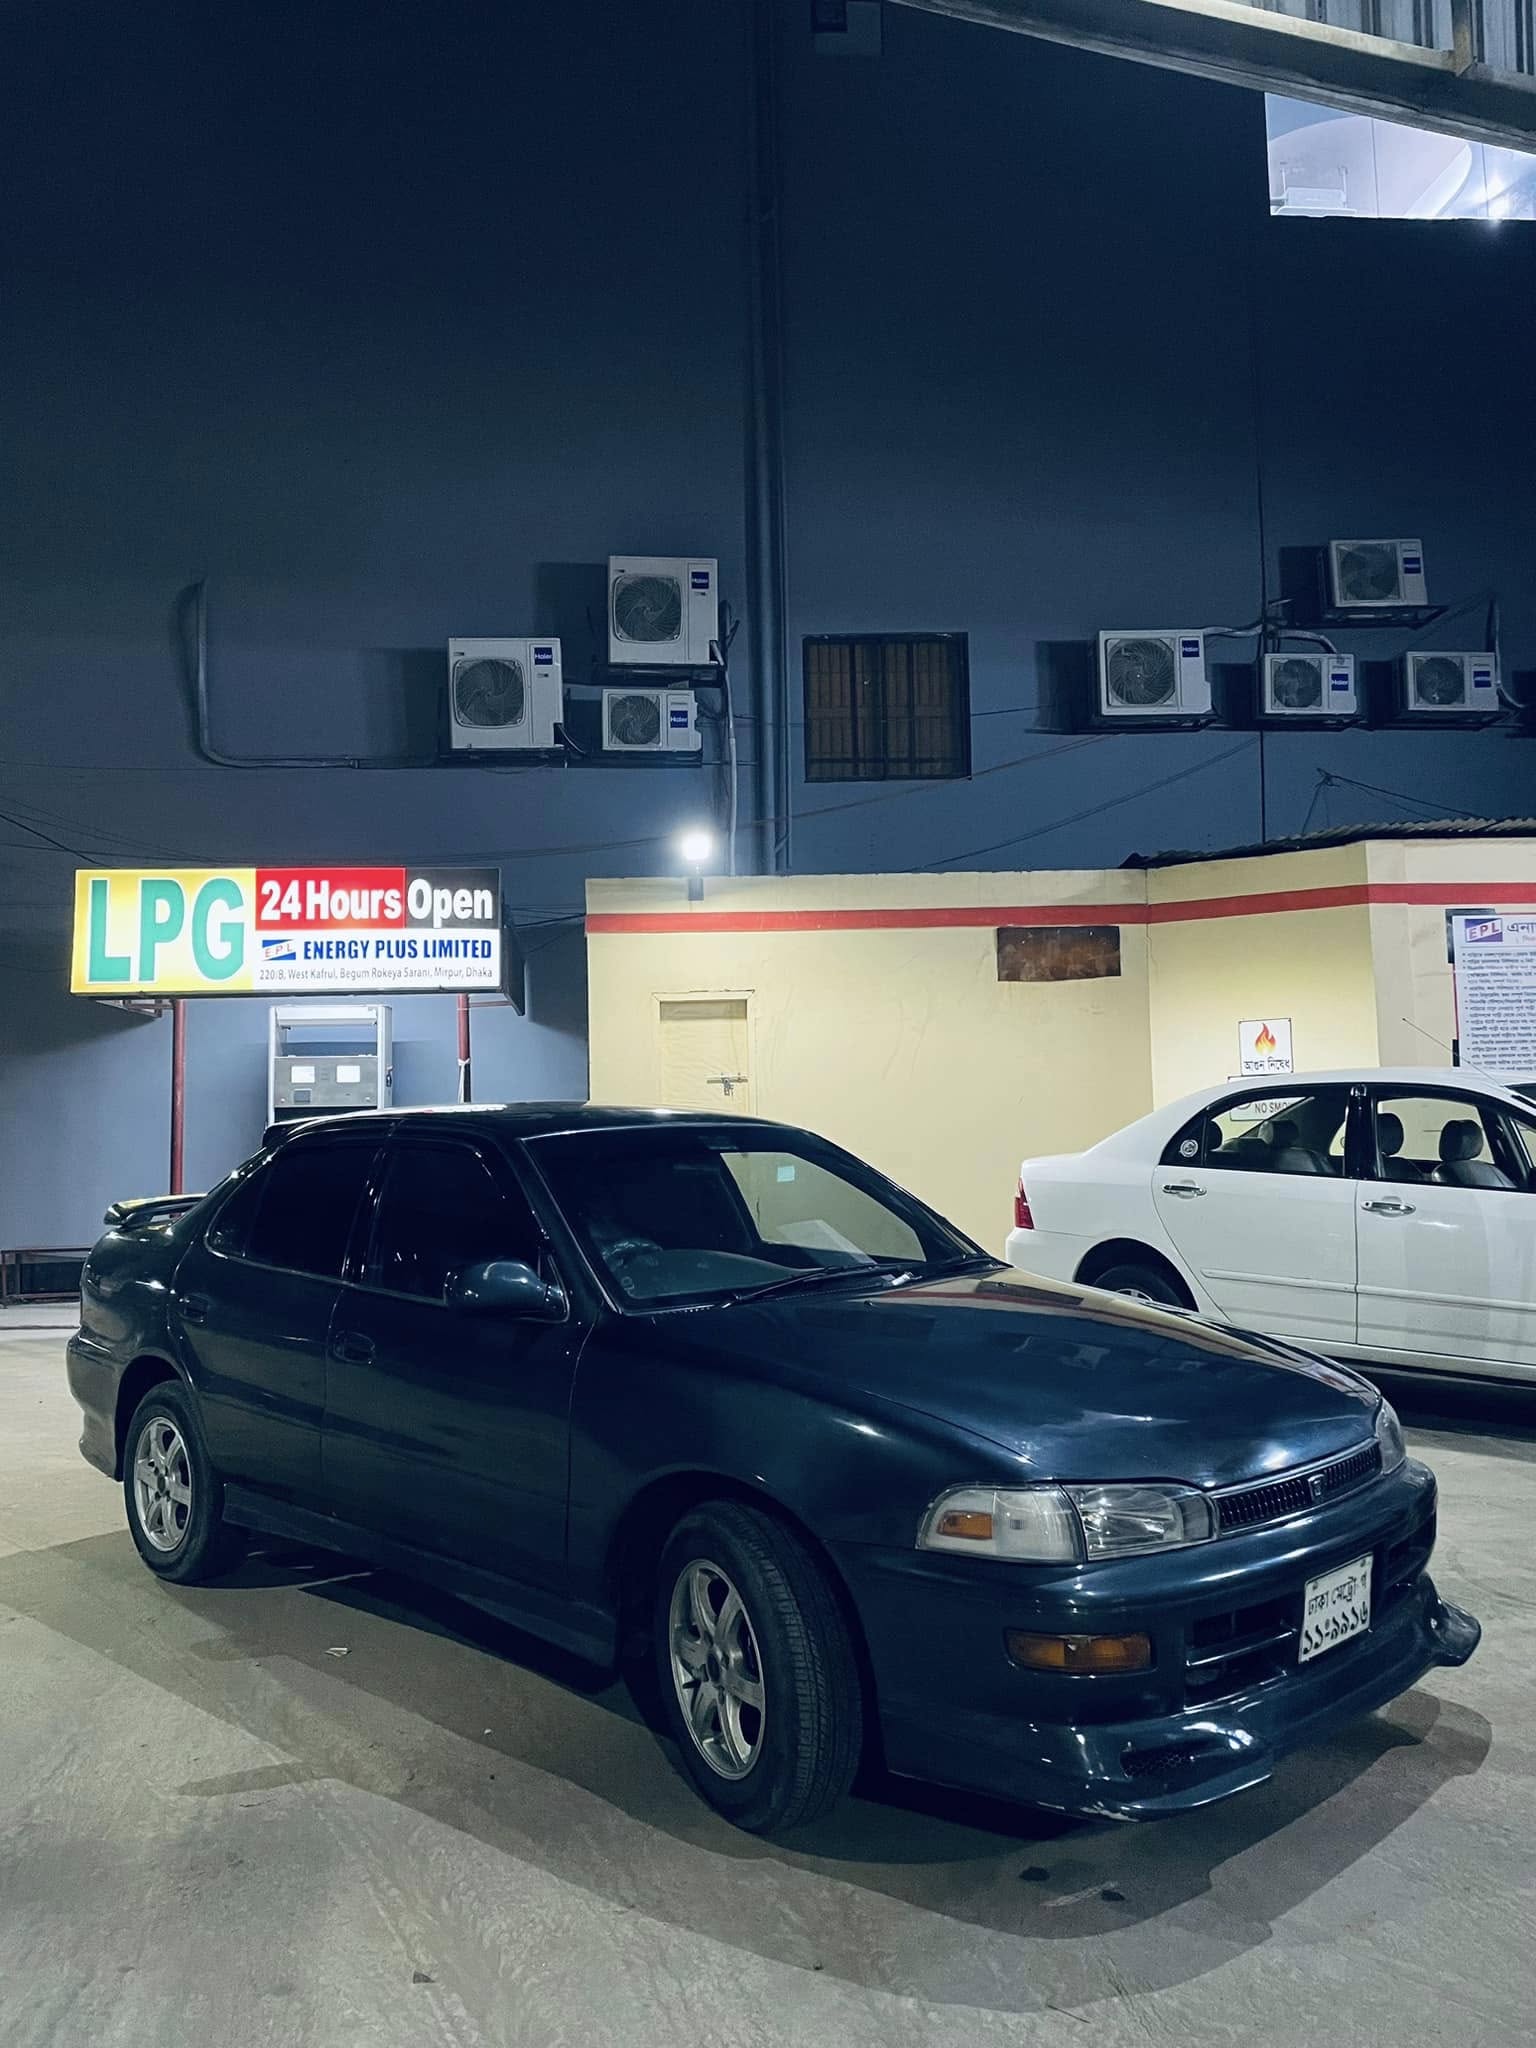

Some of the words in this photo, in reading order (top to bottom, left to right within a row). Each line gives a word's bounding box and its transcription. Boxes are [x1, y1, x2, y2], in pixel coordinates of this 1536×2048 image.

[260, 879, 302, 920] 24
[305, 879, 403, 920] Hours
[407, 878, 493, 929] Open
[88, 878, 244, 982] LPG
[1469, 922, 1500, 940] EPL
[265, 943, 294, 958] EPL
[303, 940, 369, 960] ENERGY
[375, 939, 418, 959] PLUS
[423, 939, 492, 958] LIMITED
[288, 968, 309, 979] West
[310, 967, 338, 979] Kafrul,
[340, 967, 370, 980] Begum
[371, 967, 402, 980] Rokeya
[404, 966, 432, 978] Sarani,
[434, 967, 464, 980] Mirpur,
[466, 966, 493, 978] Dhaka
[1254, 1102, 1268, 1114] NO
[1308, 1590, 1329, 1616] ঢাকা
